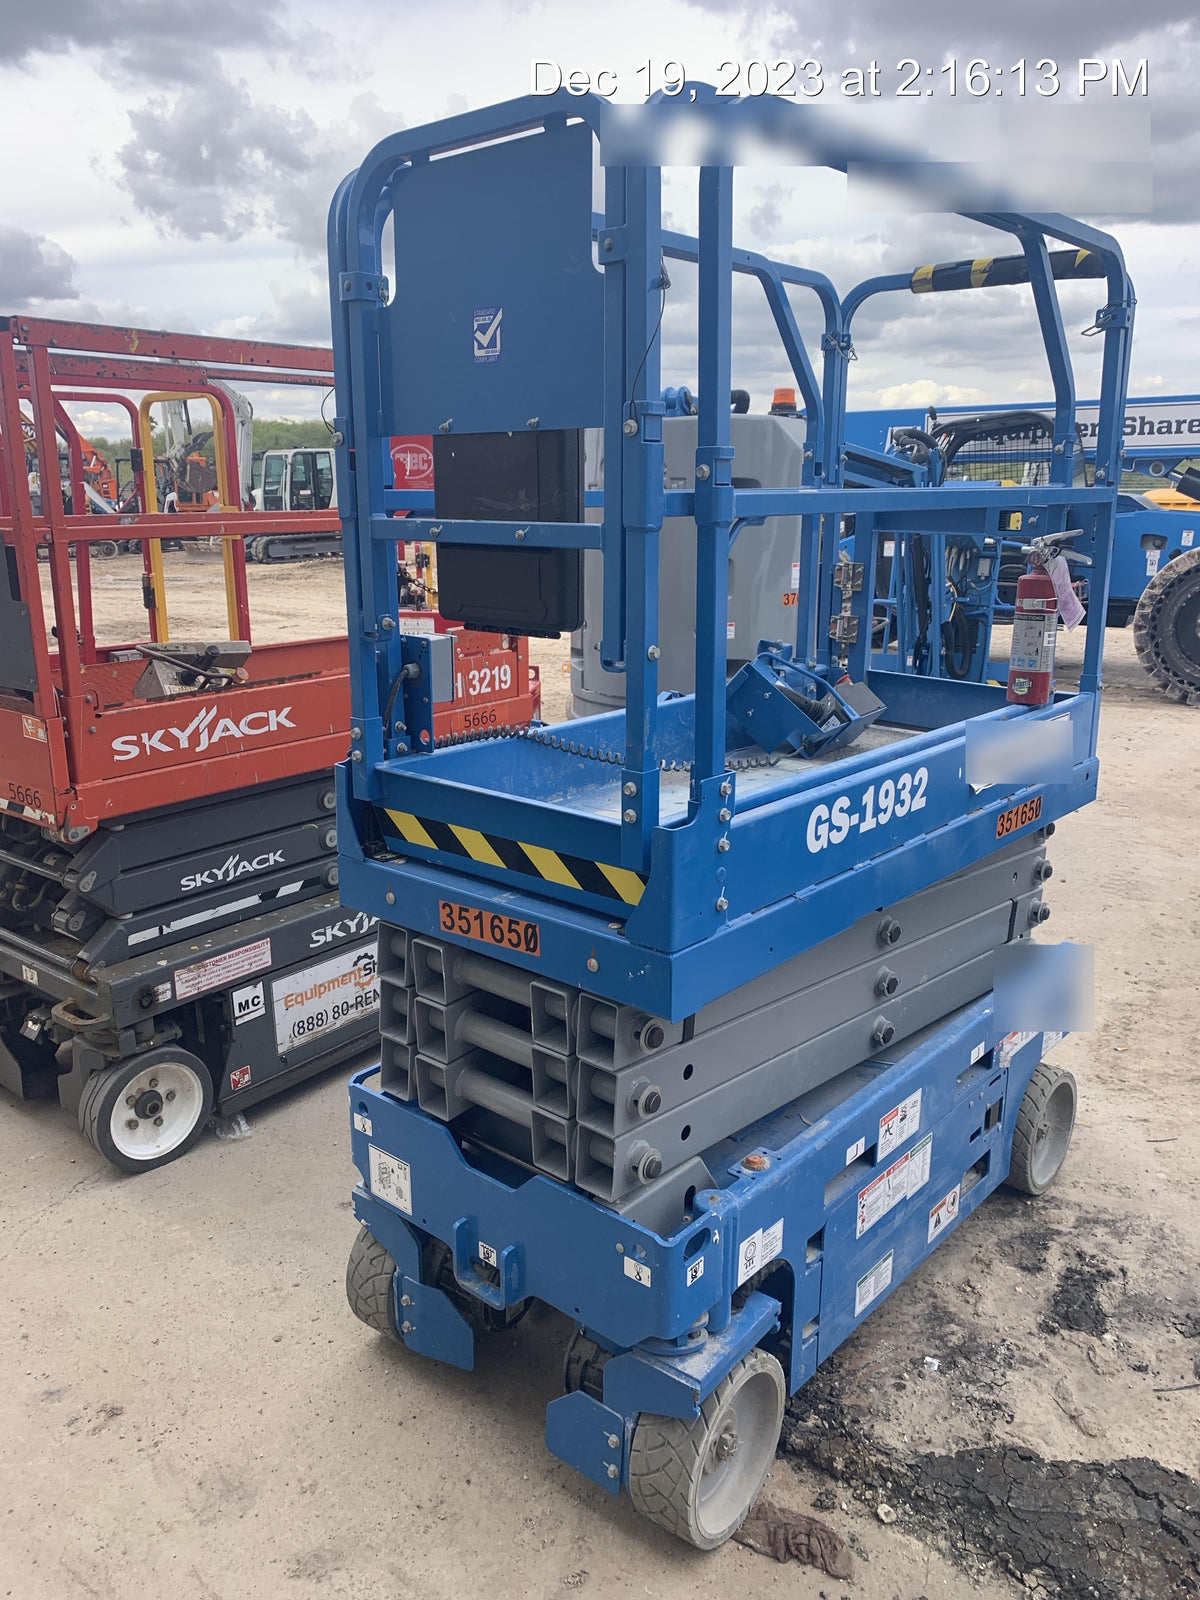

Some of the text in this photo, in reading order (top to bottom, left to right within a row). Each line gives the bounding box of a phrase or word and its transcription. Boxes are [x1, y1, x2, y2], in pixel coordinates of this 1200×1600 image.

[783, 593, 798, 606] 37
[468, 664, 511, 696] 3219
[111, 705, 297, 762] SKYJACK
[464, 709, 497, 729] 5666
[8, 782, 42, 809] 5666
[806, 766, 929, 854] GS-1932
[997, 800, 1042, 838] 351650
[180, 849, 286, 891] SKYJACK
[441, 902, 538, 953] 351650
[227, 941, 270, 960] RESPONSIBILITY
[238, 995, 261, 1013] MC
[292, 1008, 329, 1039] (888)
